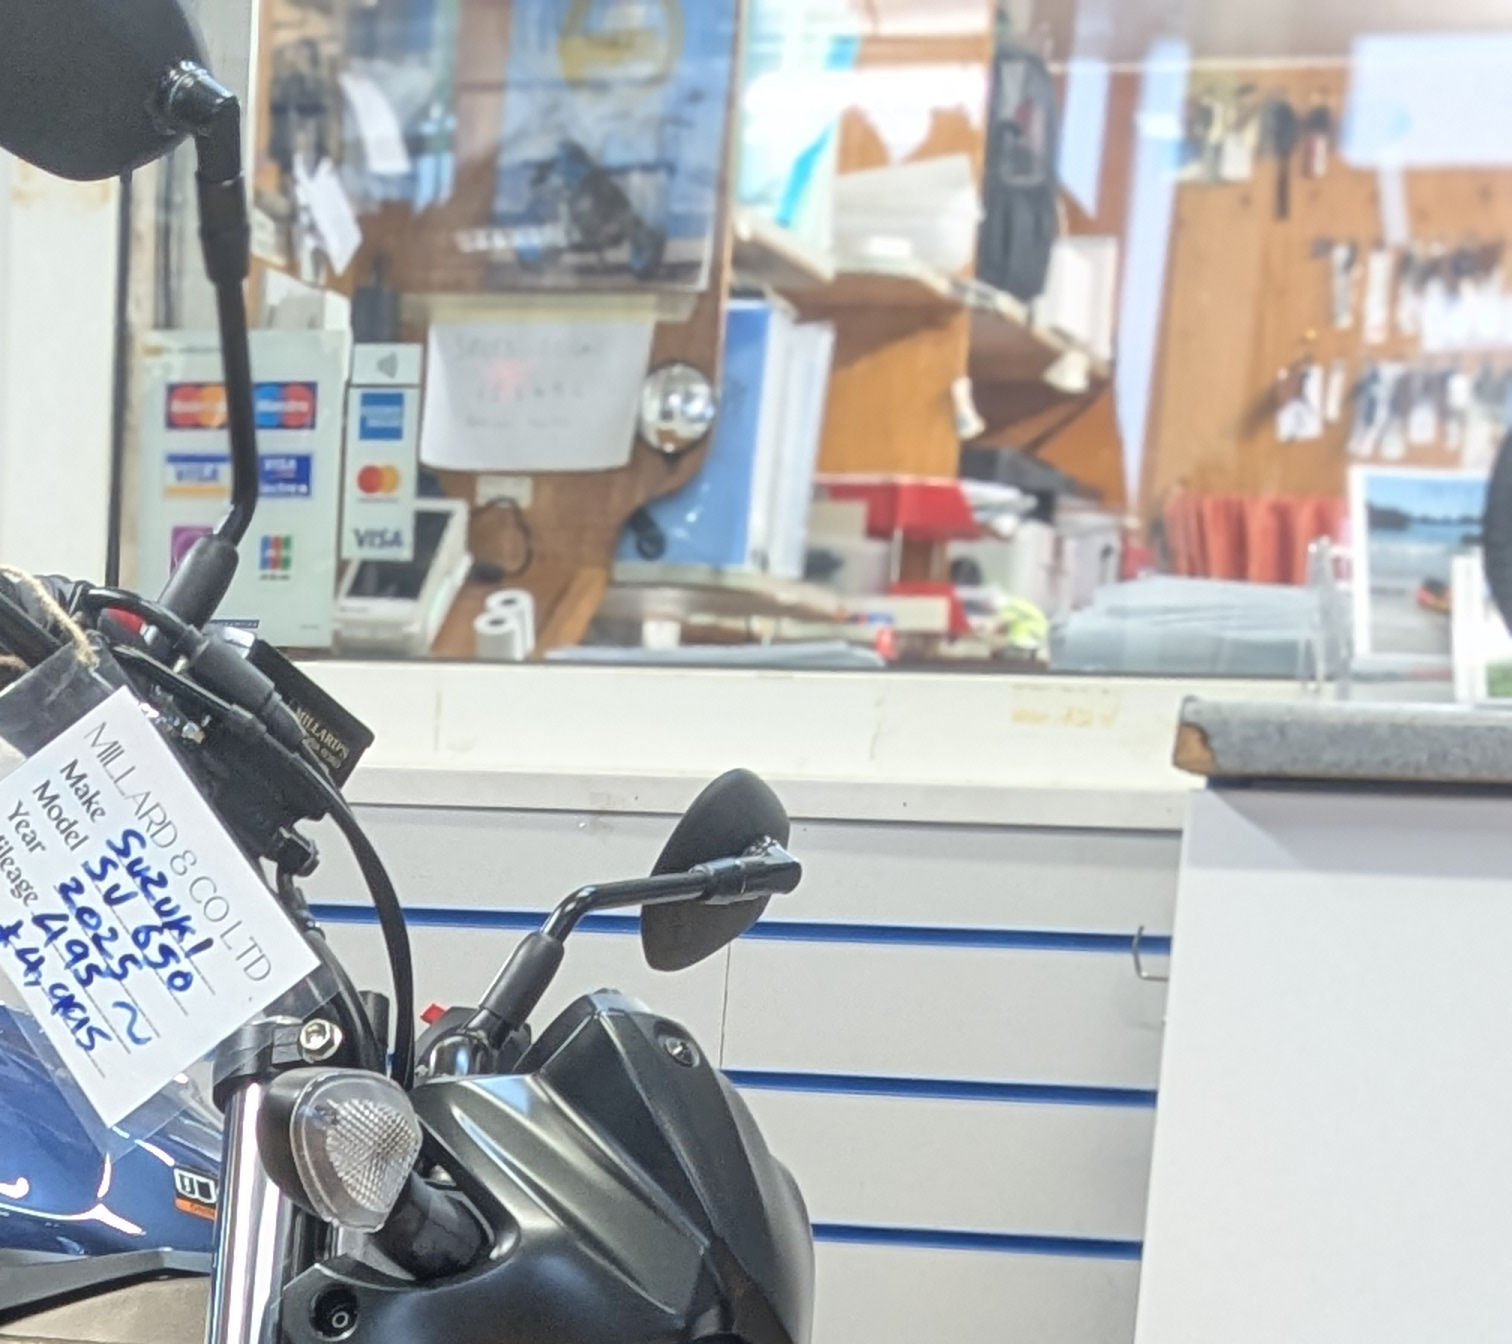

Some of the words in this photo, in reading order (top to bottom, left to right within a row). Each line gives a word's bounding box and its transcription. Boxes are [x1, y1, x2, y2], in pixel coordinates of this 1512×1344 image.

[353, 527, 403, 549] VISA
[59, 758, 107, 823] Make
[84, 721, 179, 849] MILLARD
[169, 850, 197, 876] &
[220, 919, 272, 983] LTD
[6, 800, 47, 853] Year
[57, 876, 144, 982] 2025
[32, 779, 90, 852] Model
[131, 924, 194, 992] 650
